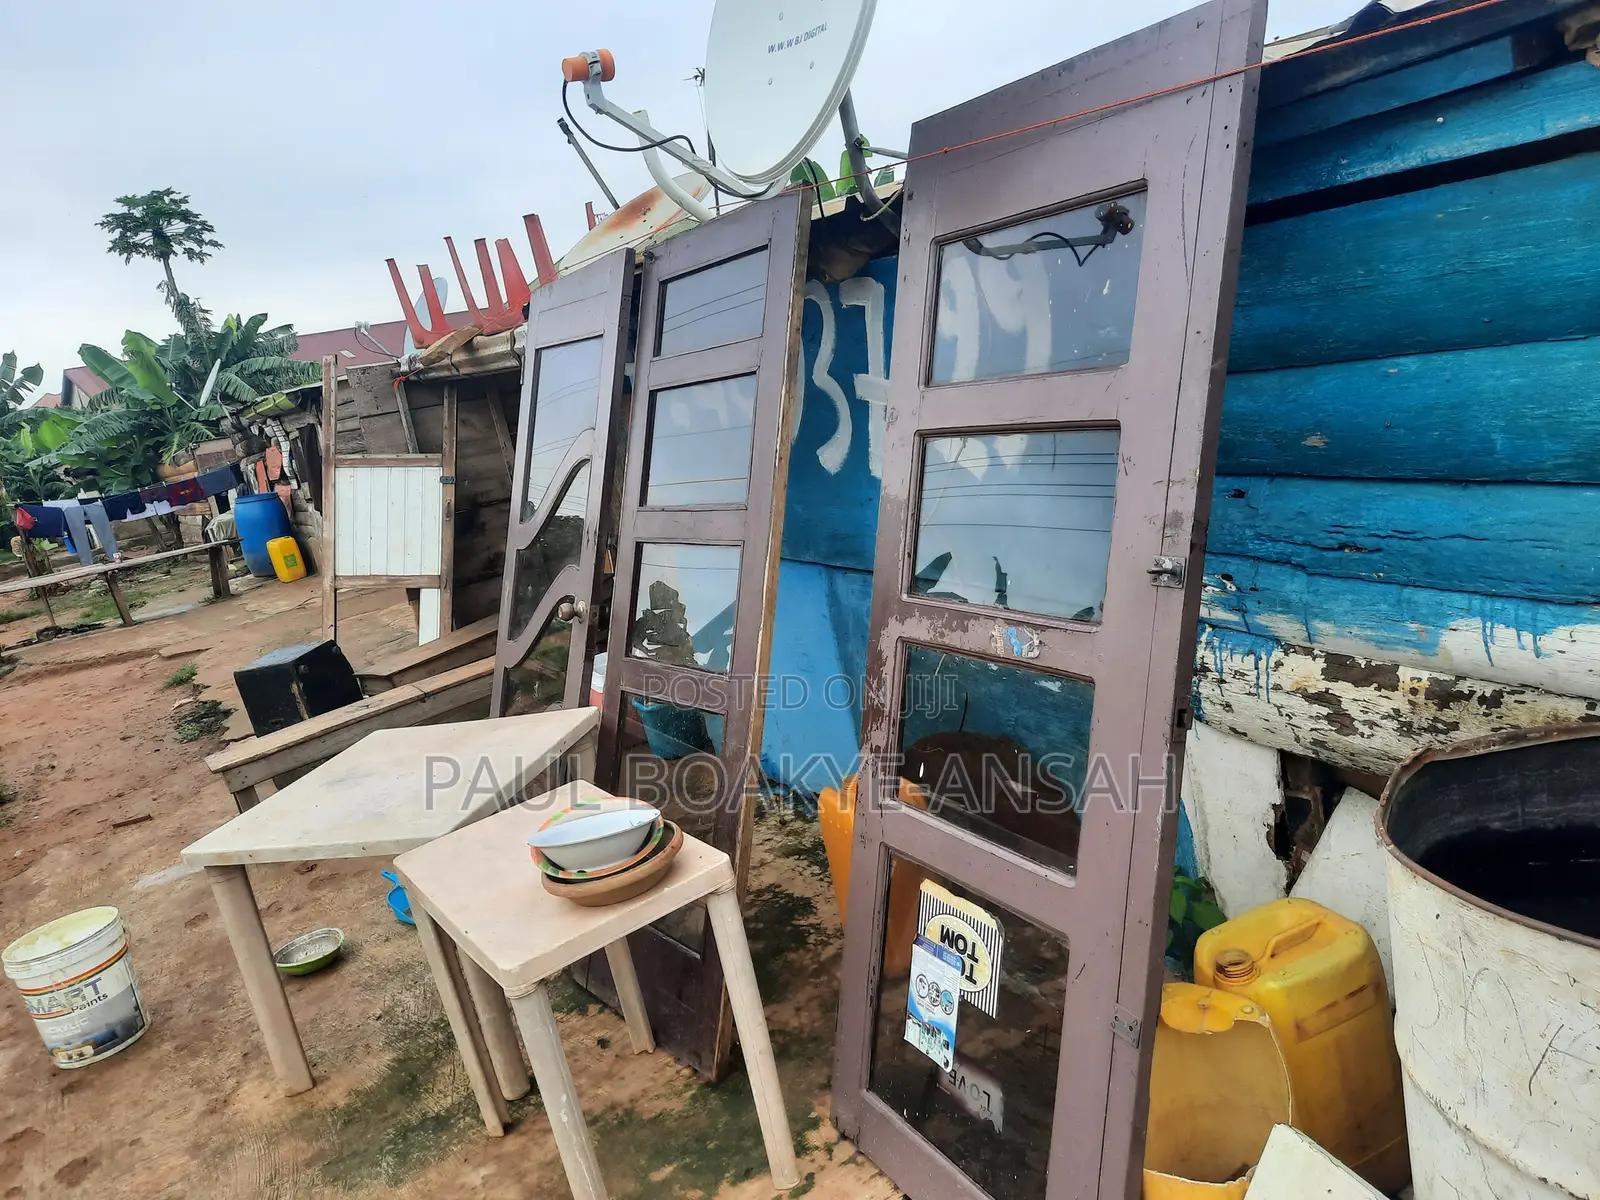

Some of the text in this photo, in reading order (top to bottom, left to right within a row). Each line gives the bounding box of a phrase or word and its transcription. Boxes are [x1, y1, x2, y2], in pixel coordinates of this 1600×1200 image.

[794, 34, 804, 46] BJ
[803, 22, 828, 42] DIGITAL
[940, 924, 979, 964] TOM
[72, 992, 109, 1013] Paints
